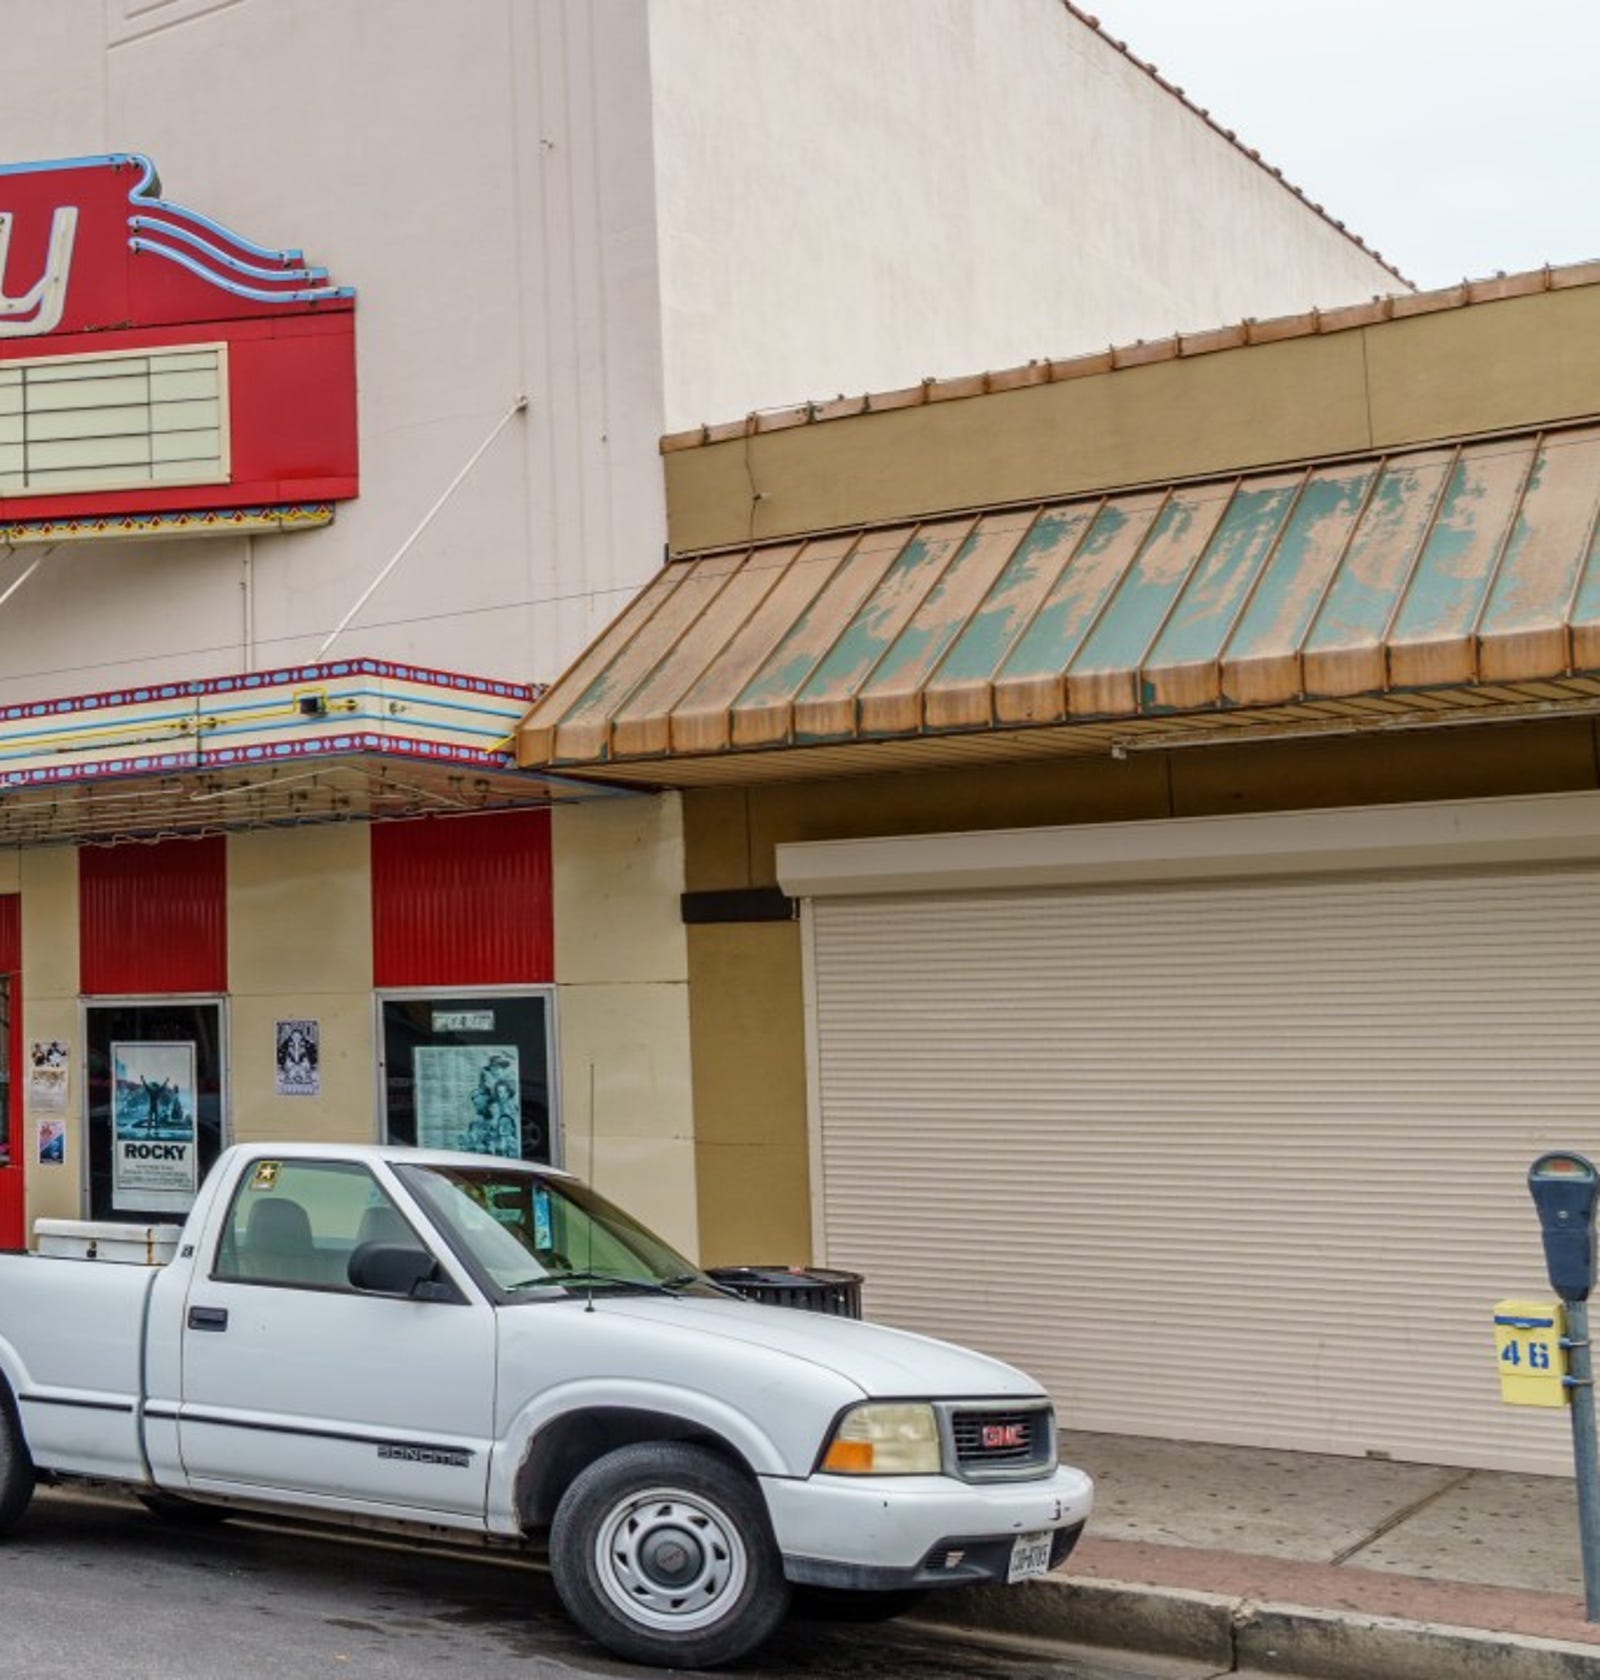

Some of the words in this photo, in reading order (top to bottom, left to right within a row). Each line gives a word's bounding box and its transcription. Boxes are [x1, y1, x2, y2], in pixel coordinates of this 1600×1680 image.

[124, 1143, 186, 1161] ROCKY
[1501, 1340, 1549, 1369] 46
[982, 1424, 1026, 1448] GMC
